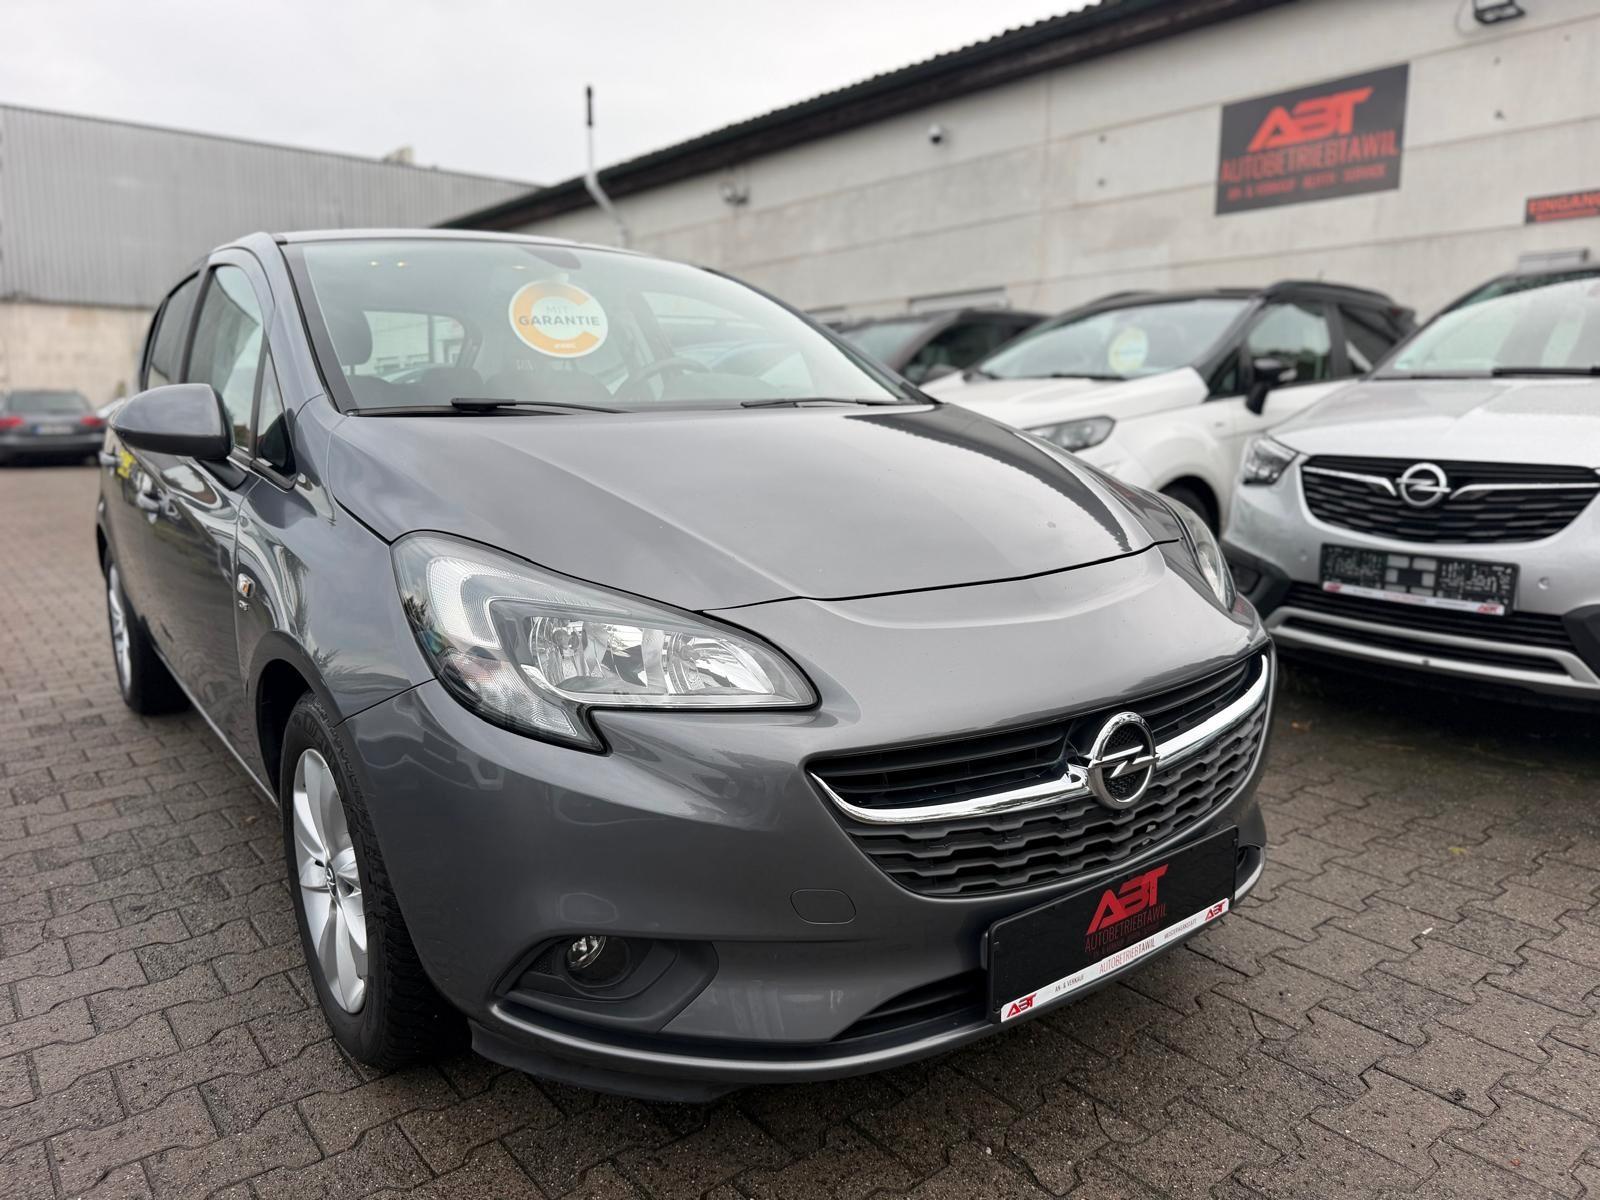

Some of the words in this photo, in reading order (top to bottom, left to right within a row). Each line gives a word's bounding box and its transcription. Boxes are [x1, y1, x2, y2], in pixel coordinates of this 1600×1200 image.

[1249, 87, 1374, 152] ABT
[1220, 131, 1398, 182] AUTOBETRIEBTAWIL
[518, 315, 601, 327] GARANTIE
[1084, 903, 1167, 953] AUTOBETRIEBTAWIL
[1086, 863, 1169, 935] ABT
[1006, 993, 1037, 1018] ABT
[1099, 938, 1156, 975] AUTOBETRIEBTAWIL
[1204, 900, 1226, 922] ABT
